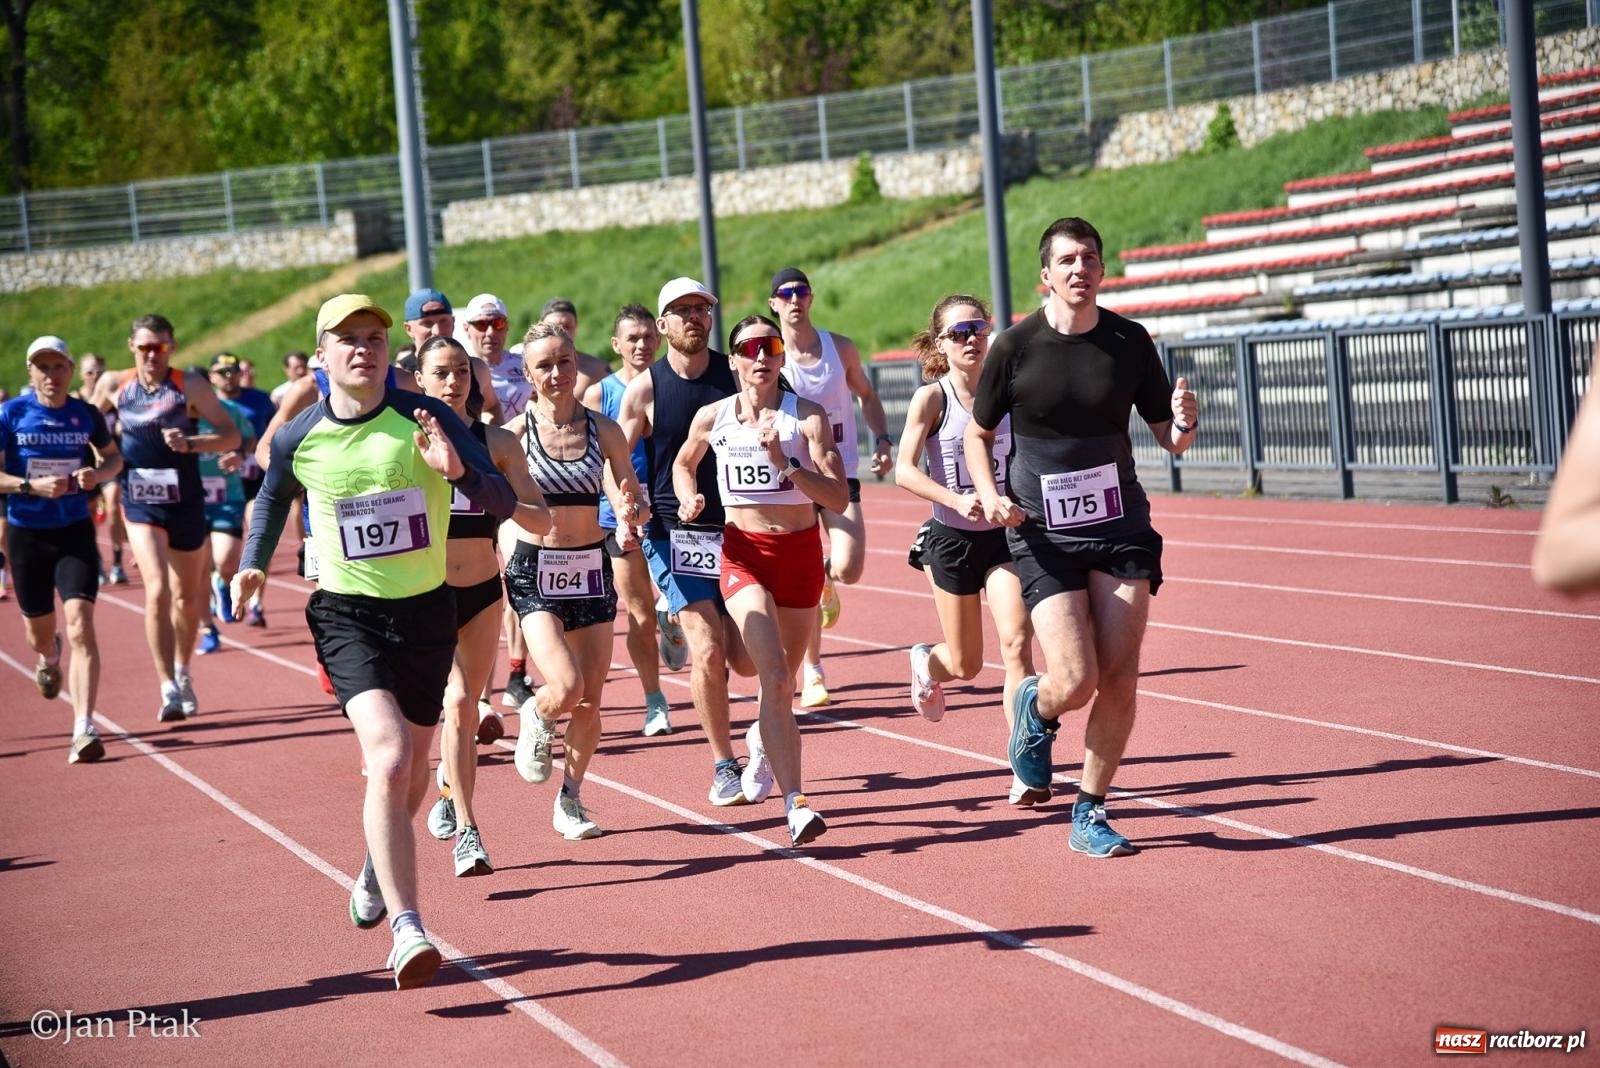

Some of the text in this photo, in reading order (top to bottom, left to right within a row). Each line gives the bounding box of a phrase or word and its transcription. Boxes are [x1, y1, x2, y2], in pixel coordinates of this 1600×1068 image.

[16, 432, 90, 446] RUNNERS
[735, 465, 771, 485] 135
[1083, 471, 1102, 480] GRANIC
[135, 484, 165, 497] 242
[1048, 483, 1077, 492] 3MAJA2026
[356, 500, 370, 509] BIEG
[371, 499, 382, 507] BEZ
[382, 495, 406, 505] GRANIC
[1058, 493, 1098, 519] 175
[341, 507, 376, 518] 3MAJA2026
[354, 520, 400, 549] 197
[680, 550, 716, 570] 223
[548, 571, 582, 590] 164
